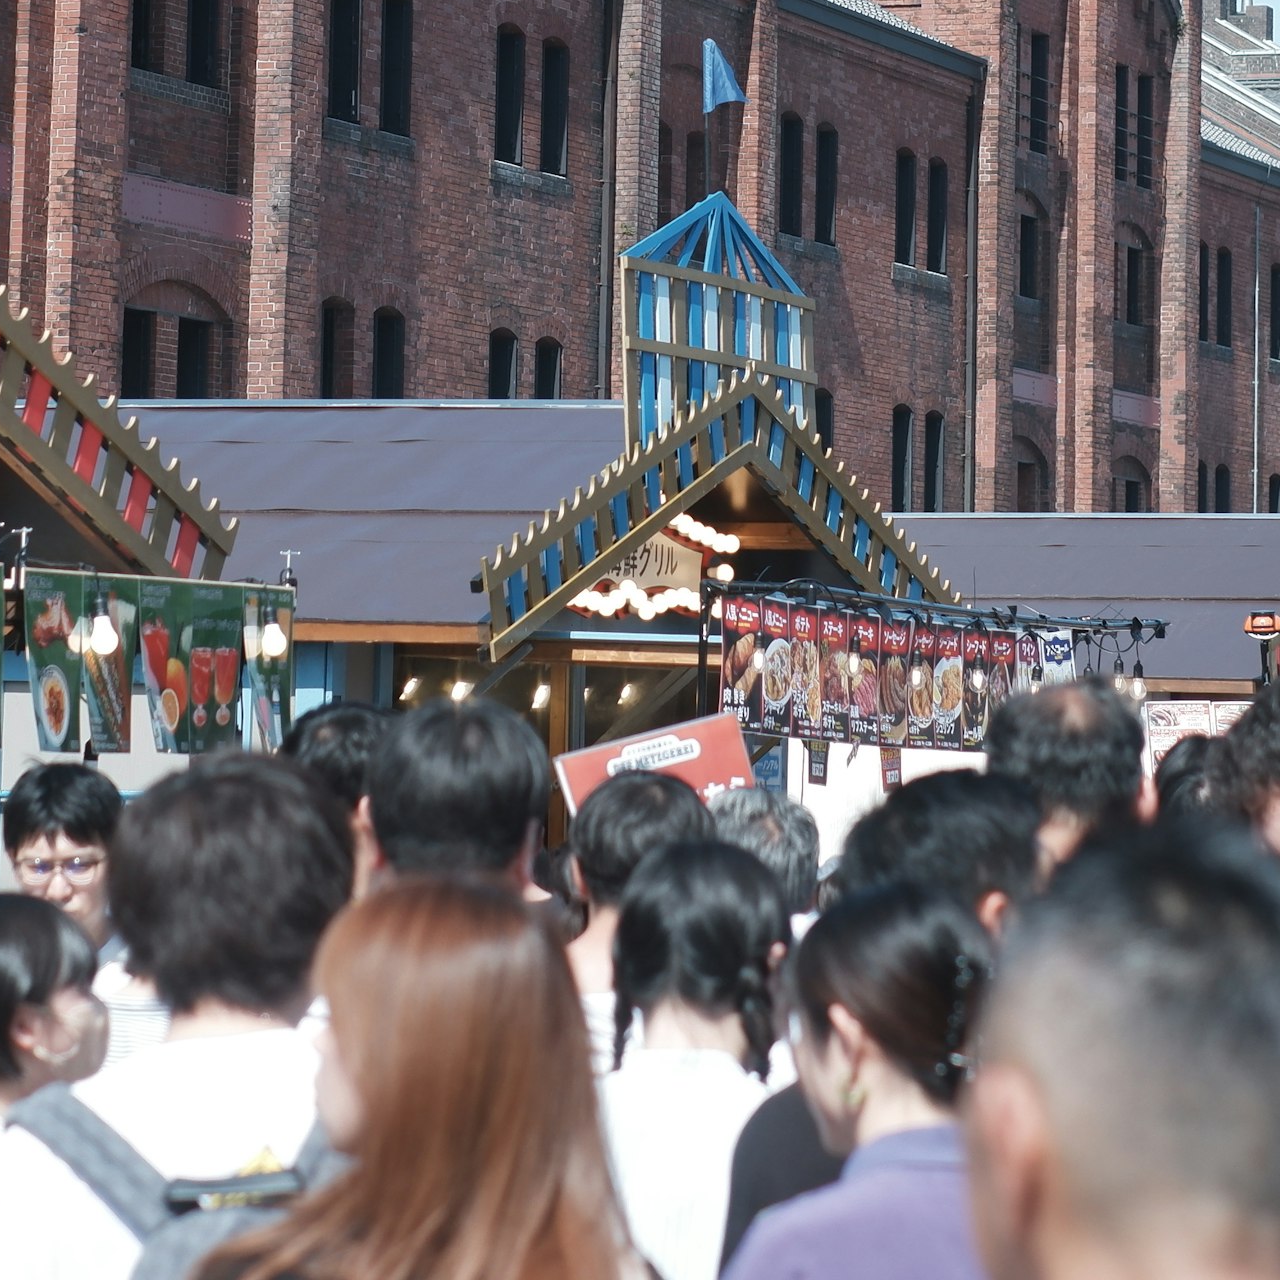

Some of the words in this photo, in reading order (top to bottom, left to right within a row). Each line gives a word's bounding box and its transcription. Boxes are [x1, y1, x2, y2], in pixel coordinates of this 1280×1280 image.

[853, 625, 875, 642] テーキ
[1021, 642, 1036, 657] ワイン
